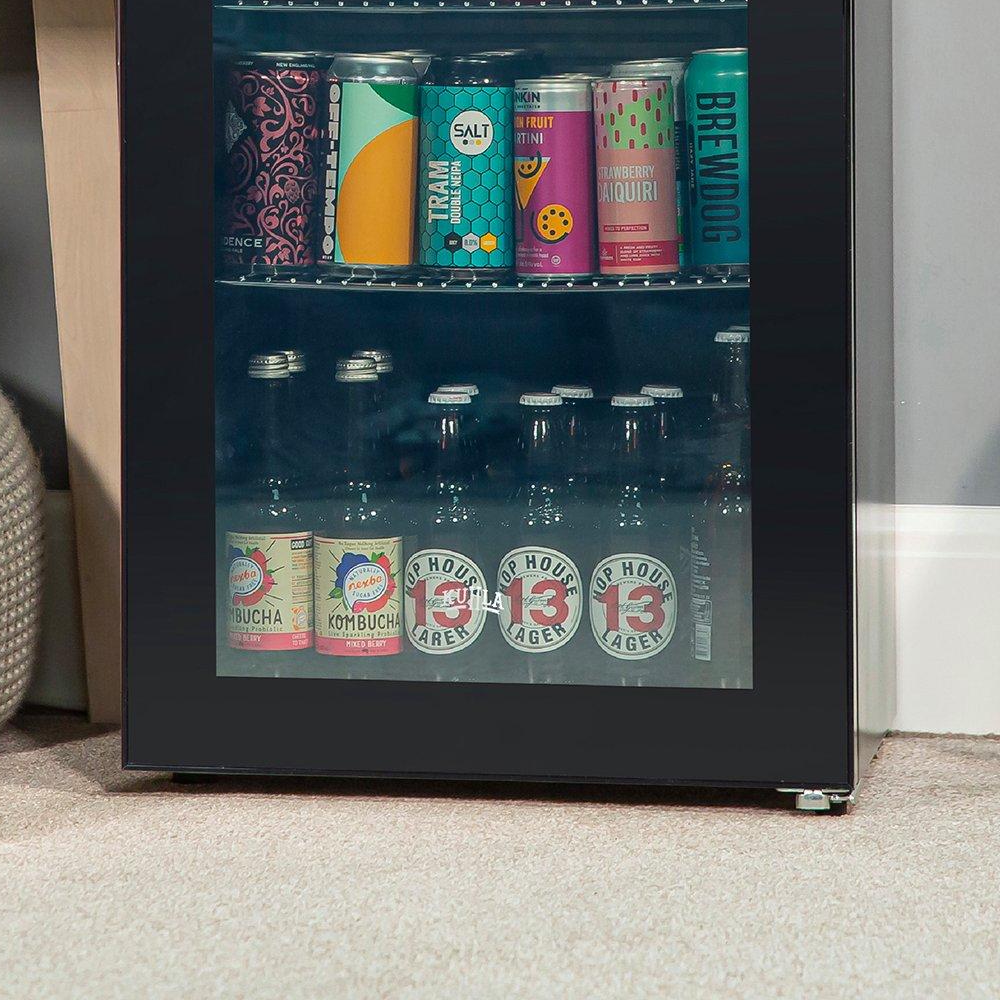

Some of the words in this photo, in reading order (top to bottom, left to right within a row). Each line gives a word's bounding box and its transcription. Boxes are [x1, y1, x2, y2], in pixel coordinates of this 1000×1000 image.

[454, 123, 489, 138] SALT
[526, 116, 554, 128] FRUIT
[515, 132, 543, 144] RTINI
[696, 92, 742, 243] BREWDOG
[428, 161, 449, 223] TRAM
[450, 190, 461, 224] DOUBLE
[348, 567, 380, 580] NATURALLY
[525, 554, 578, 598] HOUSE
[592, 567, 613, 601] HOP
[621, 561, 673, 603] HOUSE
[411, 579, 472, 628] 13
[504, 577, 569, 627] 13
[598, 585, 665, 632] 13
[328, 613, 400, 631] KOMBUCHA
[507, 622, 567, 645] LAGER
[346, 640, 366, 648] MIXED
[367, 640, 387, 648] BERRY
[602, 628, 663, 651] LAGER
